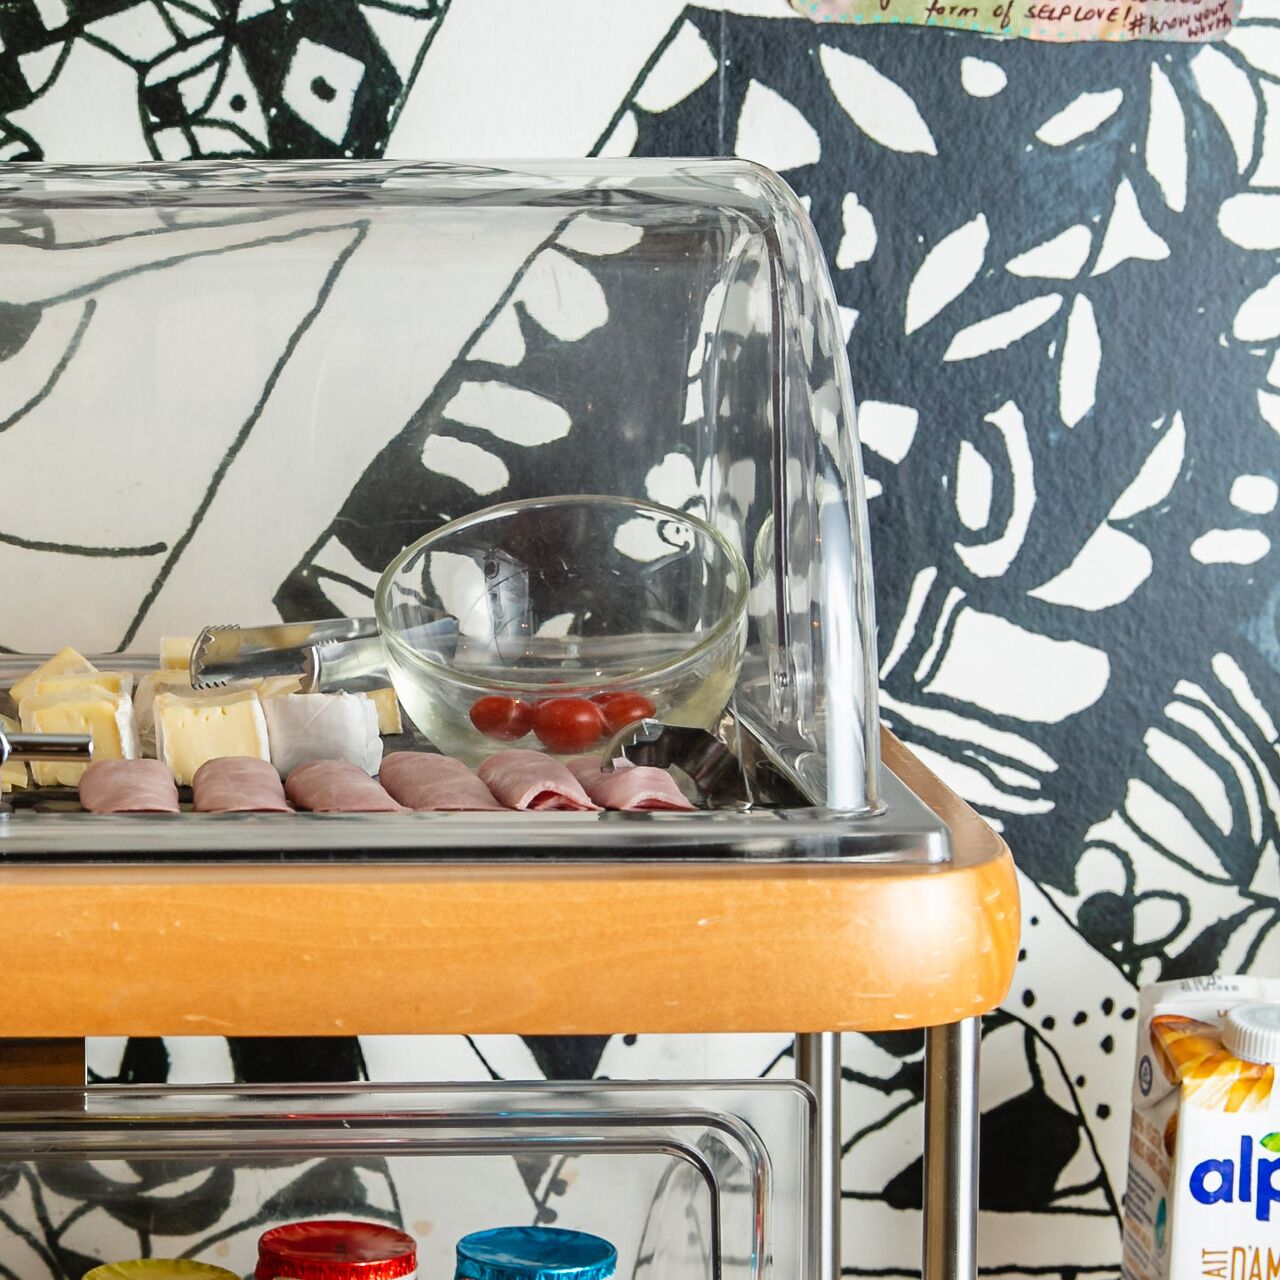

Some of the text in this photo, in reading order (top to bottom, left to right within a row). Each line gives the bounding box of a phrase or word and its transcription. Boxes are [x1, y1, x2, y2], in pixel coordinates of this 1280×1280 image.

[925, 0, 978, 24] form
[993, 0, 1014, 29] of
[1189, 1135, 1280, 1221] alp
